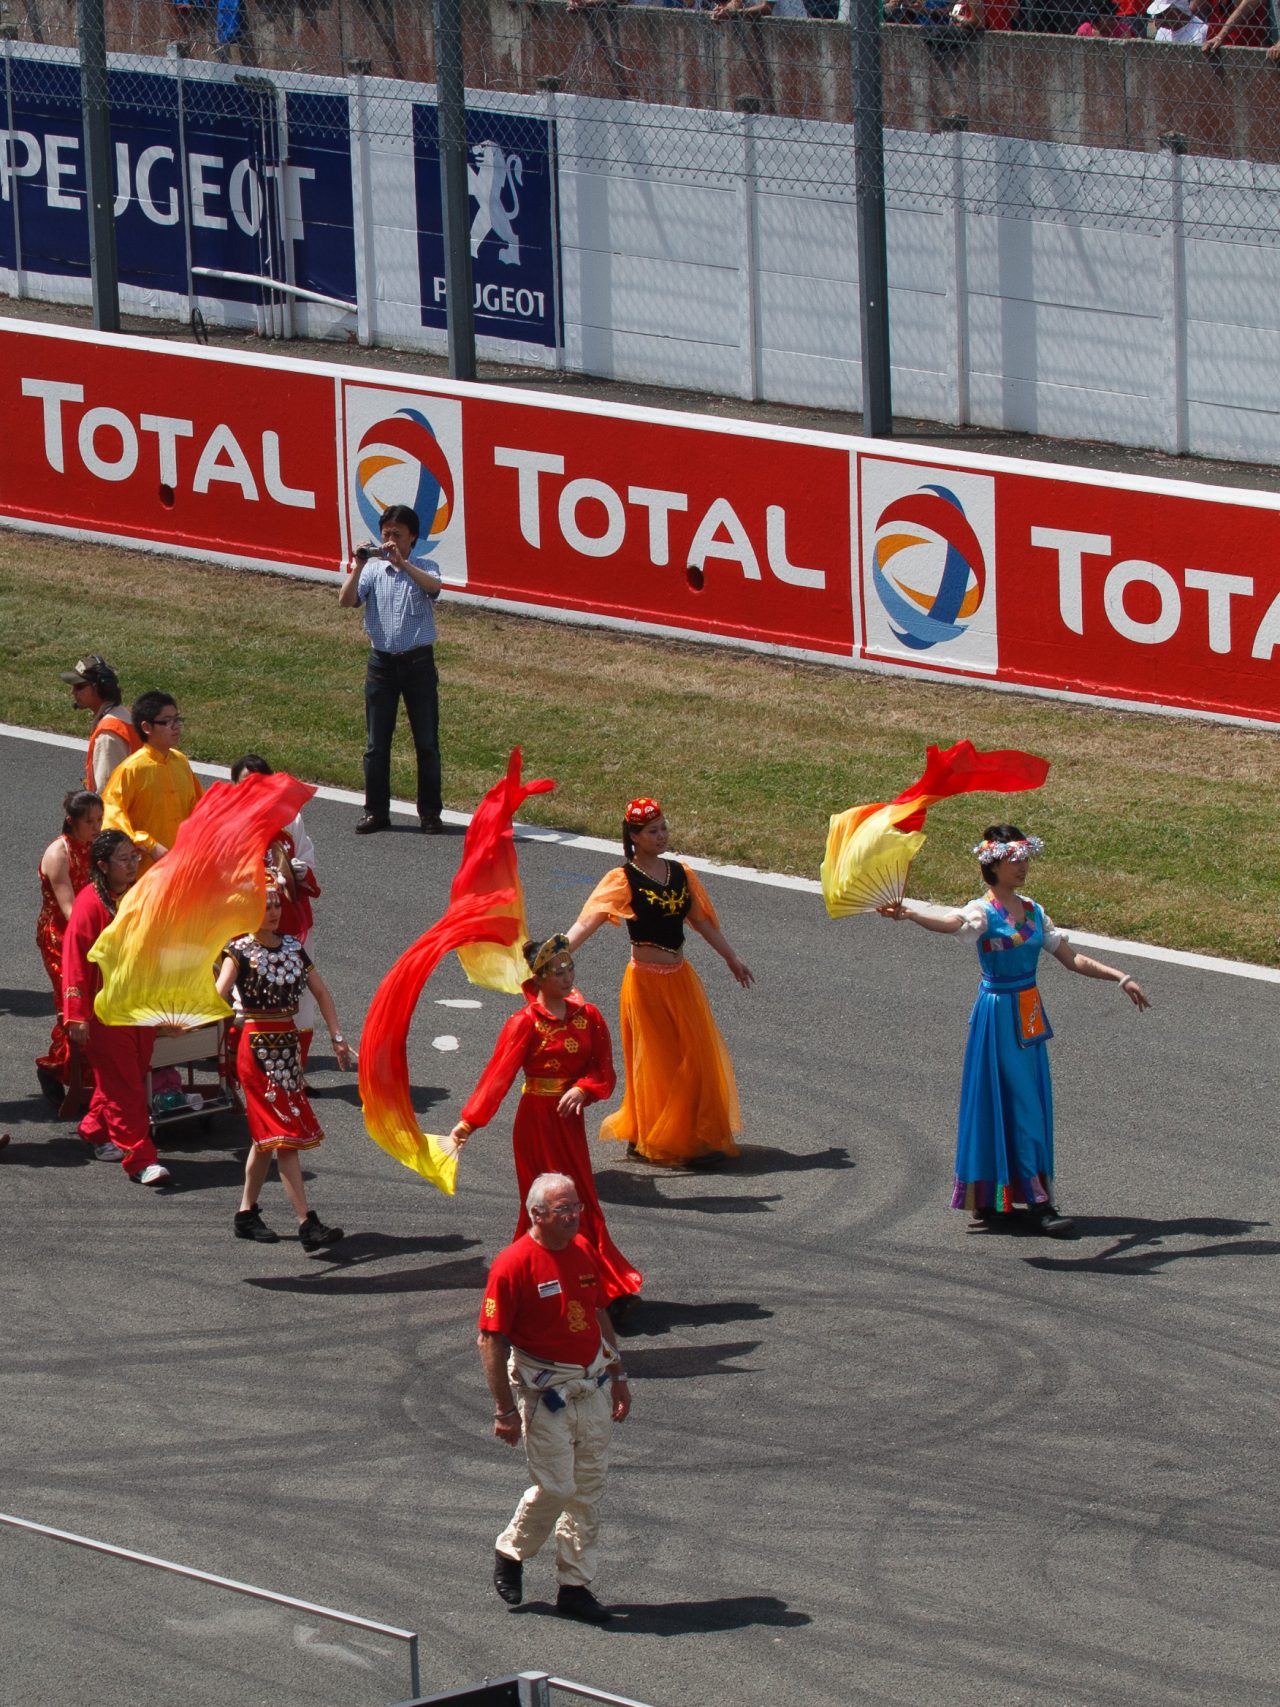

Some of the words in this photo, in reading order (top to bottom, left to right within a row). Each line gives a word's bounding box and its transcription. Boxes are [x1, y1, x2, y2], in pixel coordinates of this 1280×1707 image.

[433, 276, 545, 318] PGEOT
[21, 381, 316, 509] TOTAL
[494, 446, 826, 590] TOTAL
